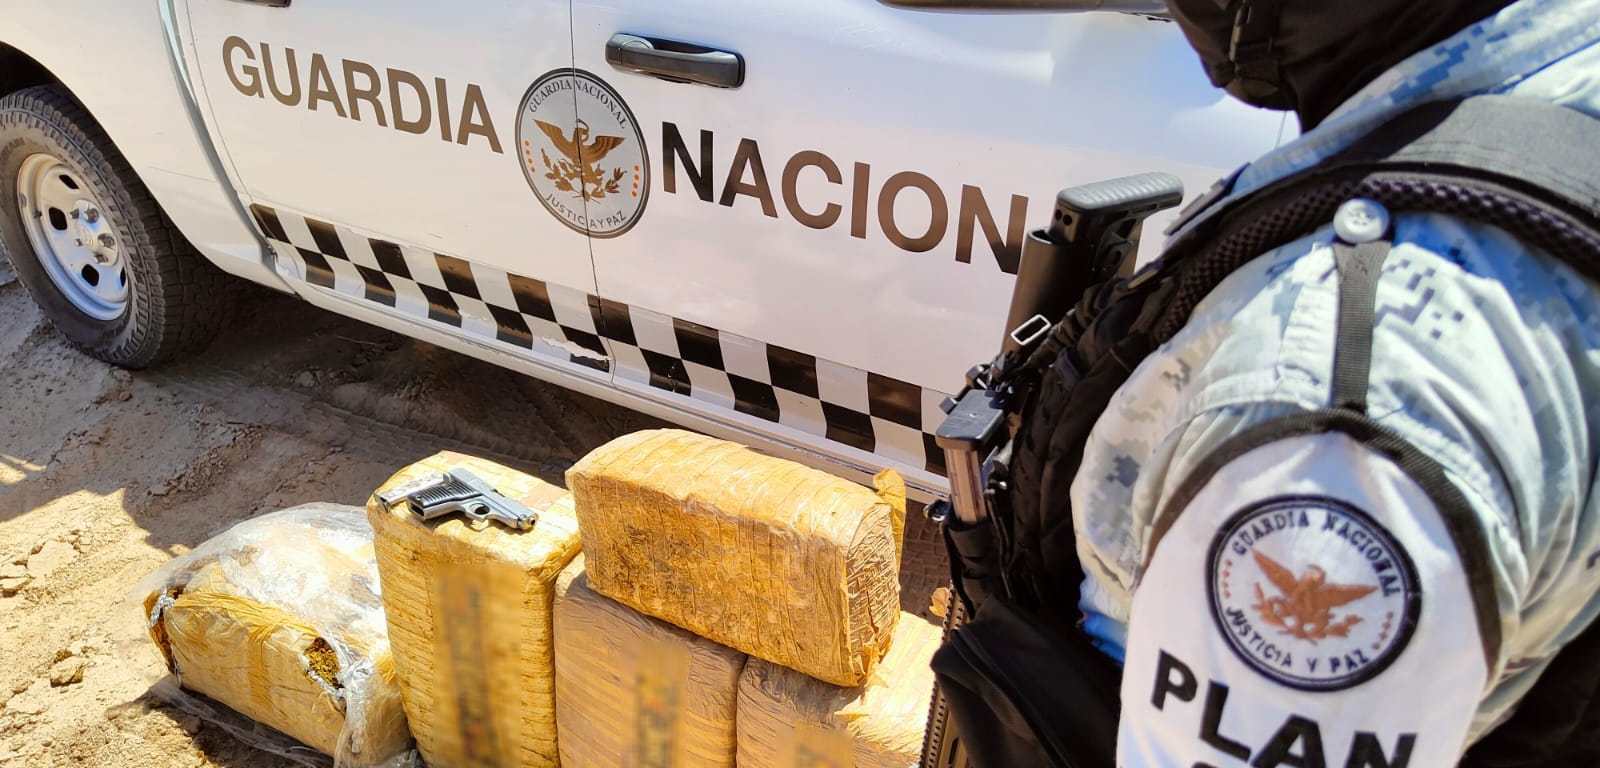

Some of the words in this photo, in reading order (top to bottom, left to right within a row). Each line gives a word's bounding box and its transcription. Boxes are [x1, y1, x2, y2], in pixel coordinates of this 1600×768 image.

[222, 36, 503, 154] GUARDIA
[530, 79, 572, 113] GUARDIA
[575, 79, 629, 129] NACIONAL
[546, 193, 596, 229] JUSTICA
[595, 218, 607, 229] Y
[606, 210, 627, 226] PAZ
[1232, 511, 1310, 556] GUARDIA
[1322, 512, 1401, 598] NACIONAL
[1226, 605, 1293, 668] JUSTICIA
[1306, 657, 1318, 673] Y
[1329, 649, 1370, 673] PAZ
[1151, 649, 1417, 768] PLAN
